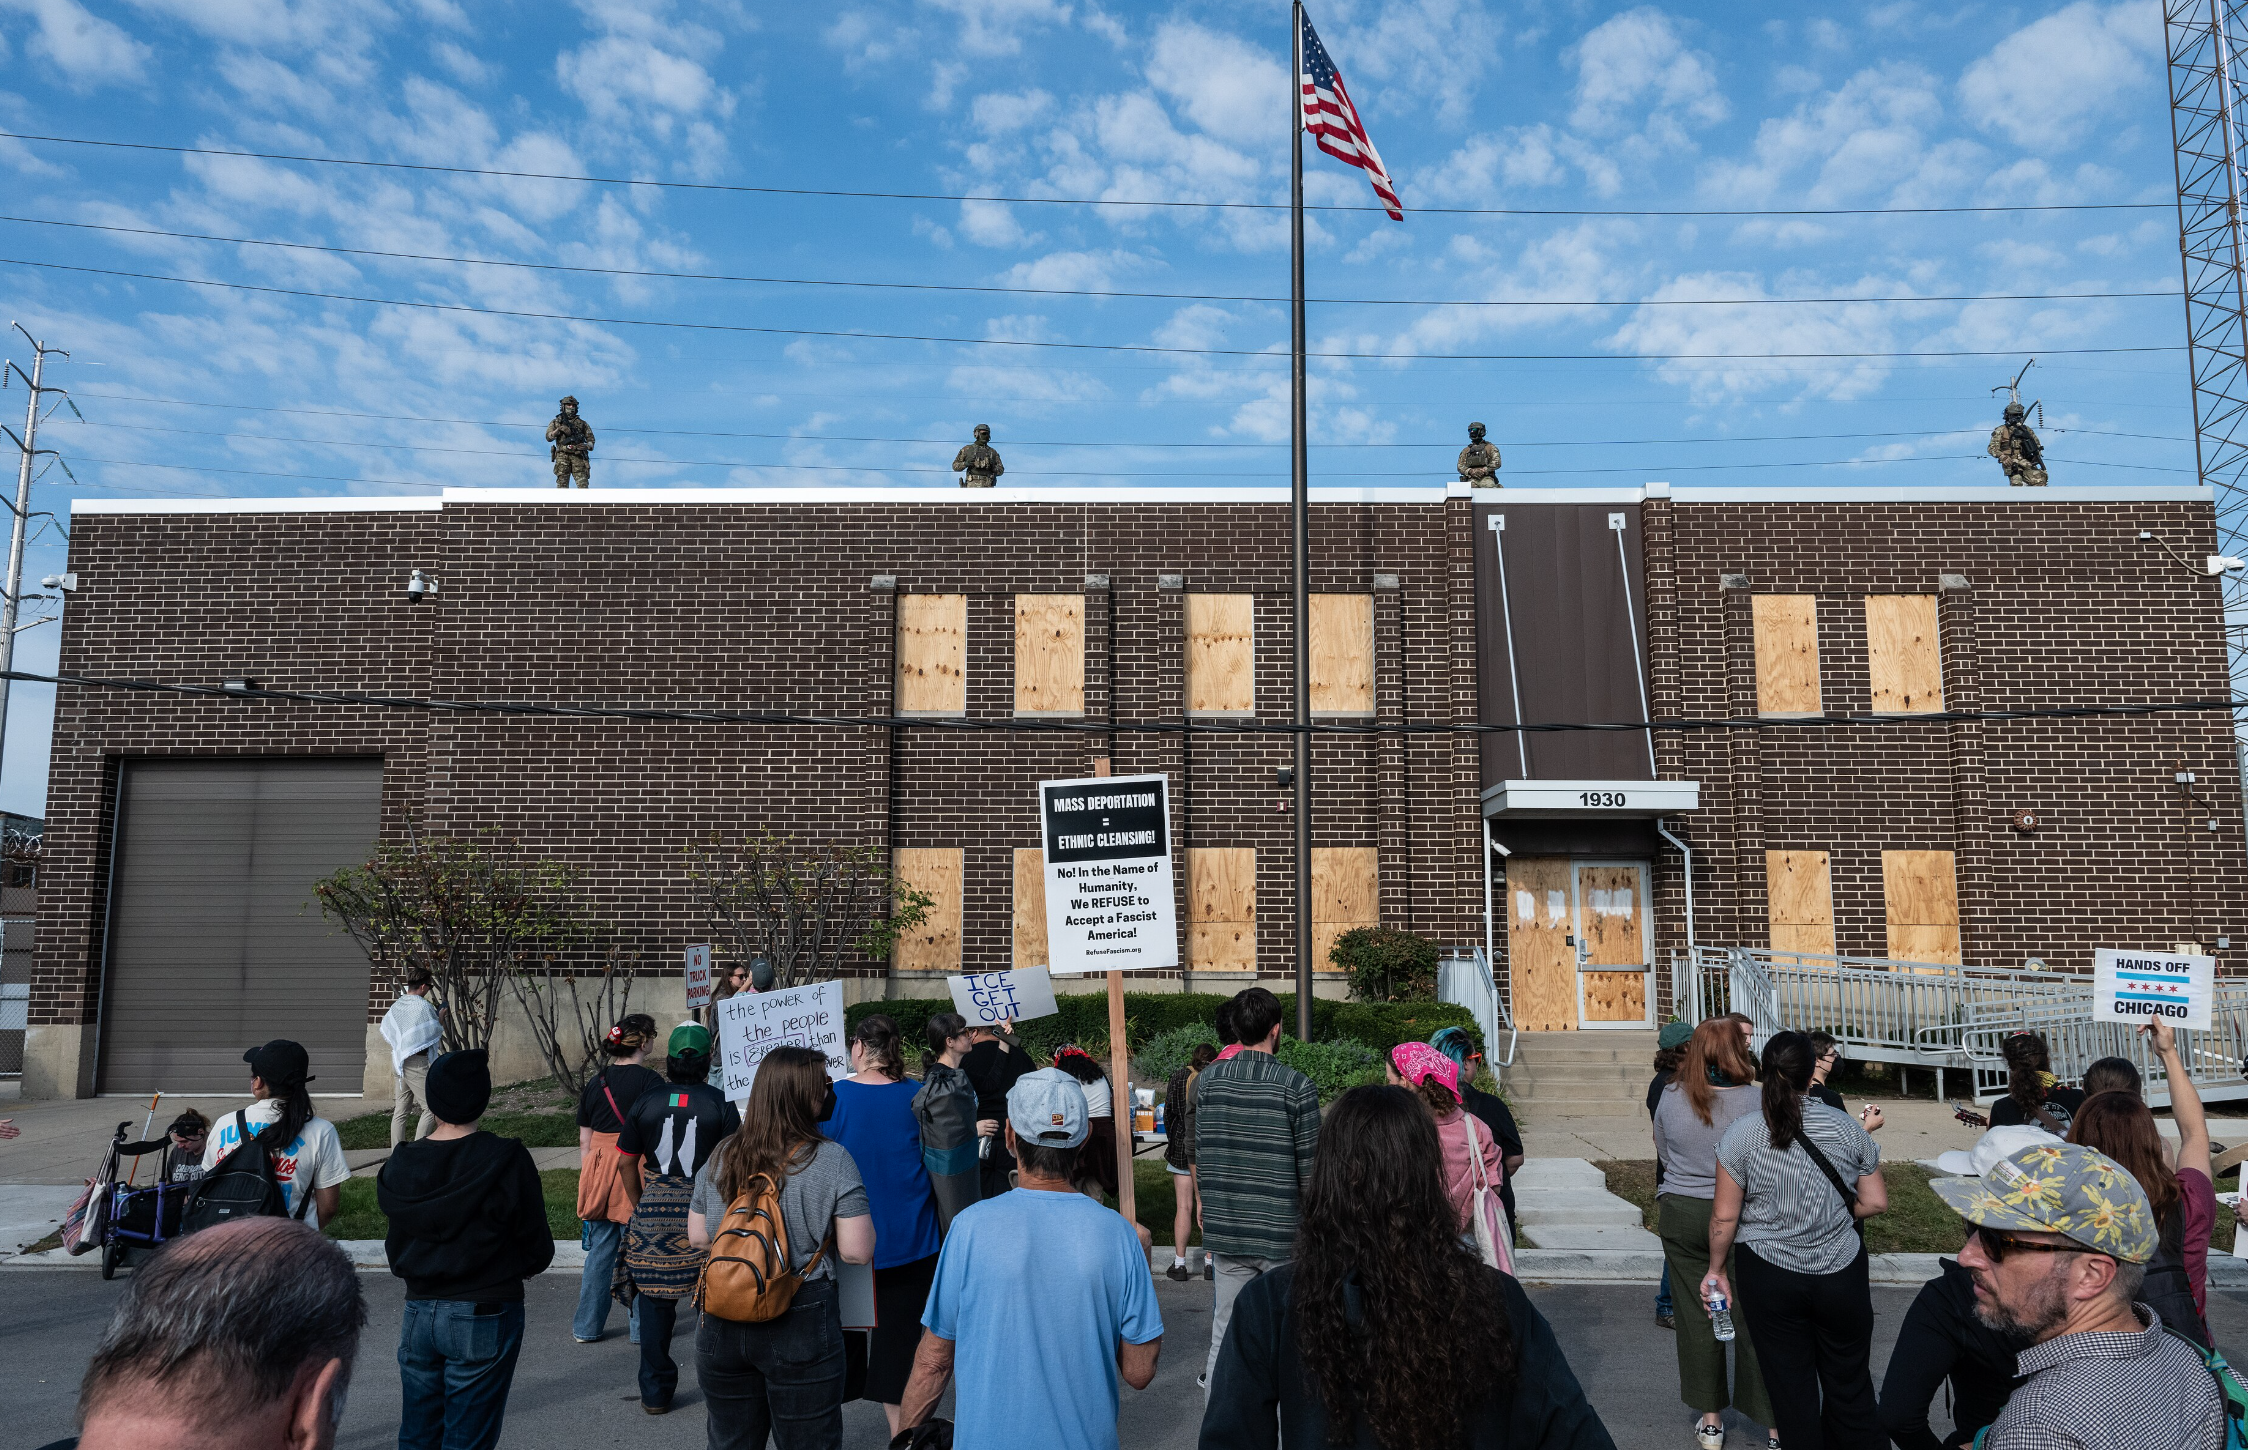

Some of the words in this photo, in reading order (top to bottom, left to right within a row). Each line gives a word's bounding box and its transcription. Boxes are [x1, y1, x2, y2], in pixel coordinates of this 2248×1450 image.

[1054, 797, 1085, 812] MASS
[1087, 793, 1156, 811] DEPORTATION
[1580, 792, 1625, 807] 1930
[1102, 817, 1110, 826] =
[1058, 833, 1095, 849] ETHNIC
[1097, 830, 1156, 847] CLEANSING!
[1057, 867, 1076, 879] No!
[1078, 867, 1089, 878] In
[1091, 865, 1111, 877] the
[1112, 864, 1145, 876] Name
[1147, 861, 1159, 873] of
[1079, 880, 1138, 893] Humanity,
[1070, 899, 1089, 910] We
[1091, 895, 1136, 909] REFUSE
[1137, 896, 1150, 906] to
[1065, 914, 1105, 927] Accept
[1107, 915, 1114, 924] a
[1116, 911, 1157, 923] Fascist
[1087, 927, 1137, 941] America!
[693, 954, 702, 966] NO
[1085, 947, 1142, 956] RefuseFascism.org
[2116, 958, 2162, 972] HANDS
[2165, 962, 2191, 973] OFF
[689, 969, 707, 983] TRUCK
[963, 971, 1014, 992] ICE
[687, 984, 710, 1000] PARKING
[972, 987, 1016, 1007] GET
[726, 1002, 756, 1021] the
[811, 985, 827, 1006] of
[2114, 1001, 2188, 1019] CHICAGO
[979, 1002, 1021, 1022] OUT
[742, 1023, 772, 1043] the
[782, 1010, 829, 1040] people
[728, 1050, 742, 1067] is
[809, 1031, 837, 1050] than
[726, 1073, 750, 1091] the
